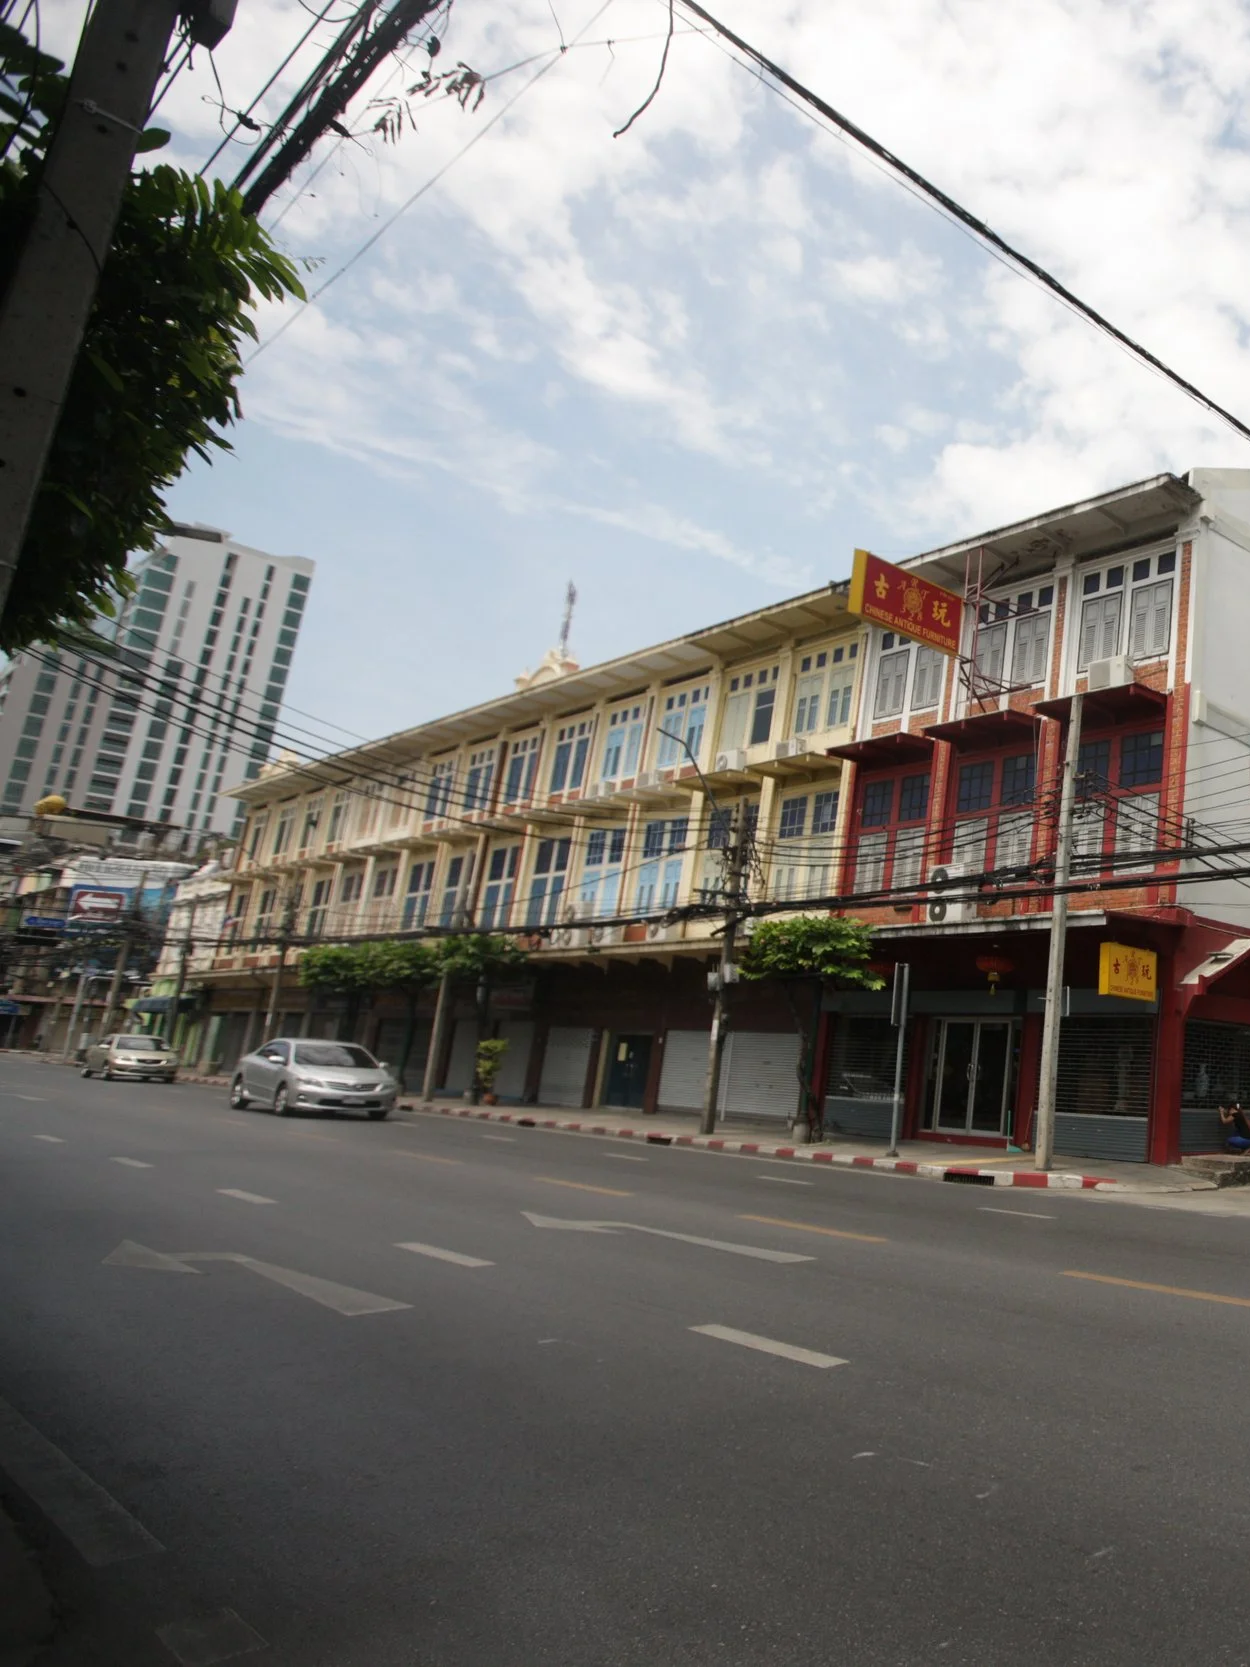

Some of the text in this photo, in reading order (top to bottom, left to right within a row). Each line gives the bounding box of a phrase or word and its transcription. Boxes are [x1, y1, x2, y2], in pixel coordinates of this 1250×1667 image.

[874, 573, 951, 628] 古 玩
[864, 603, 956, 649] CHINESE ANTIQUE FURNITURE
